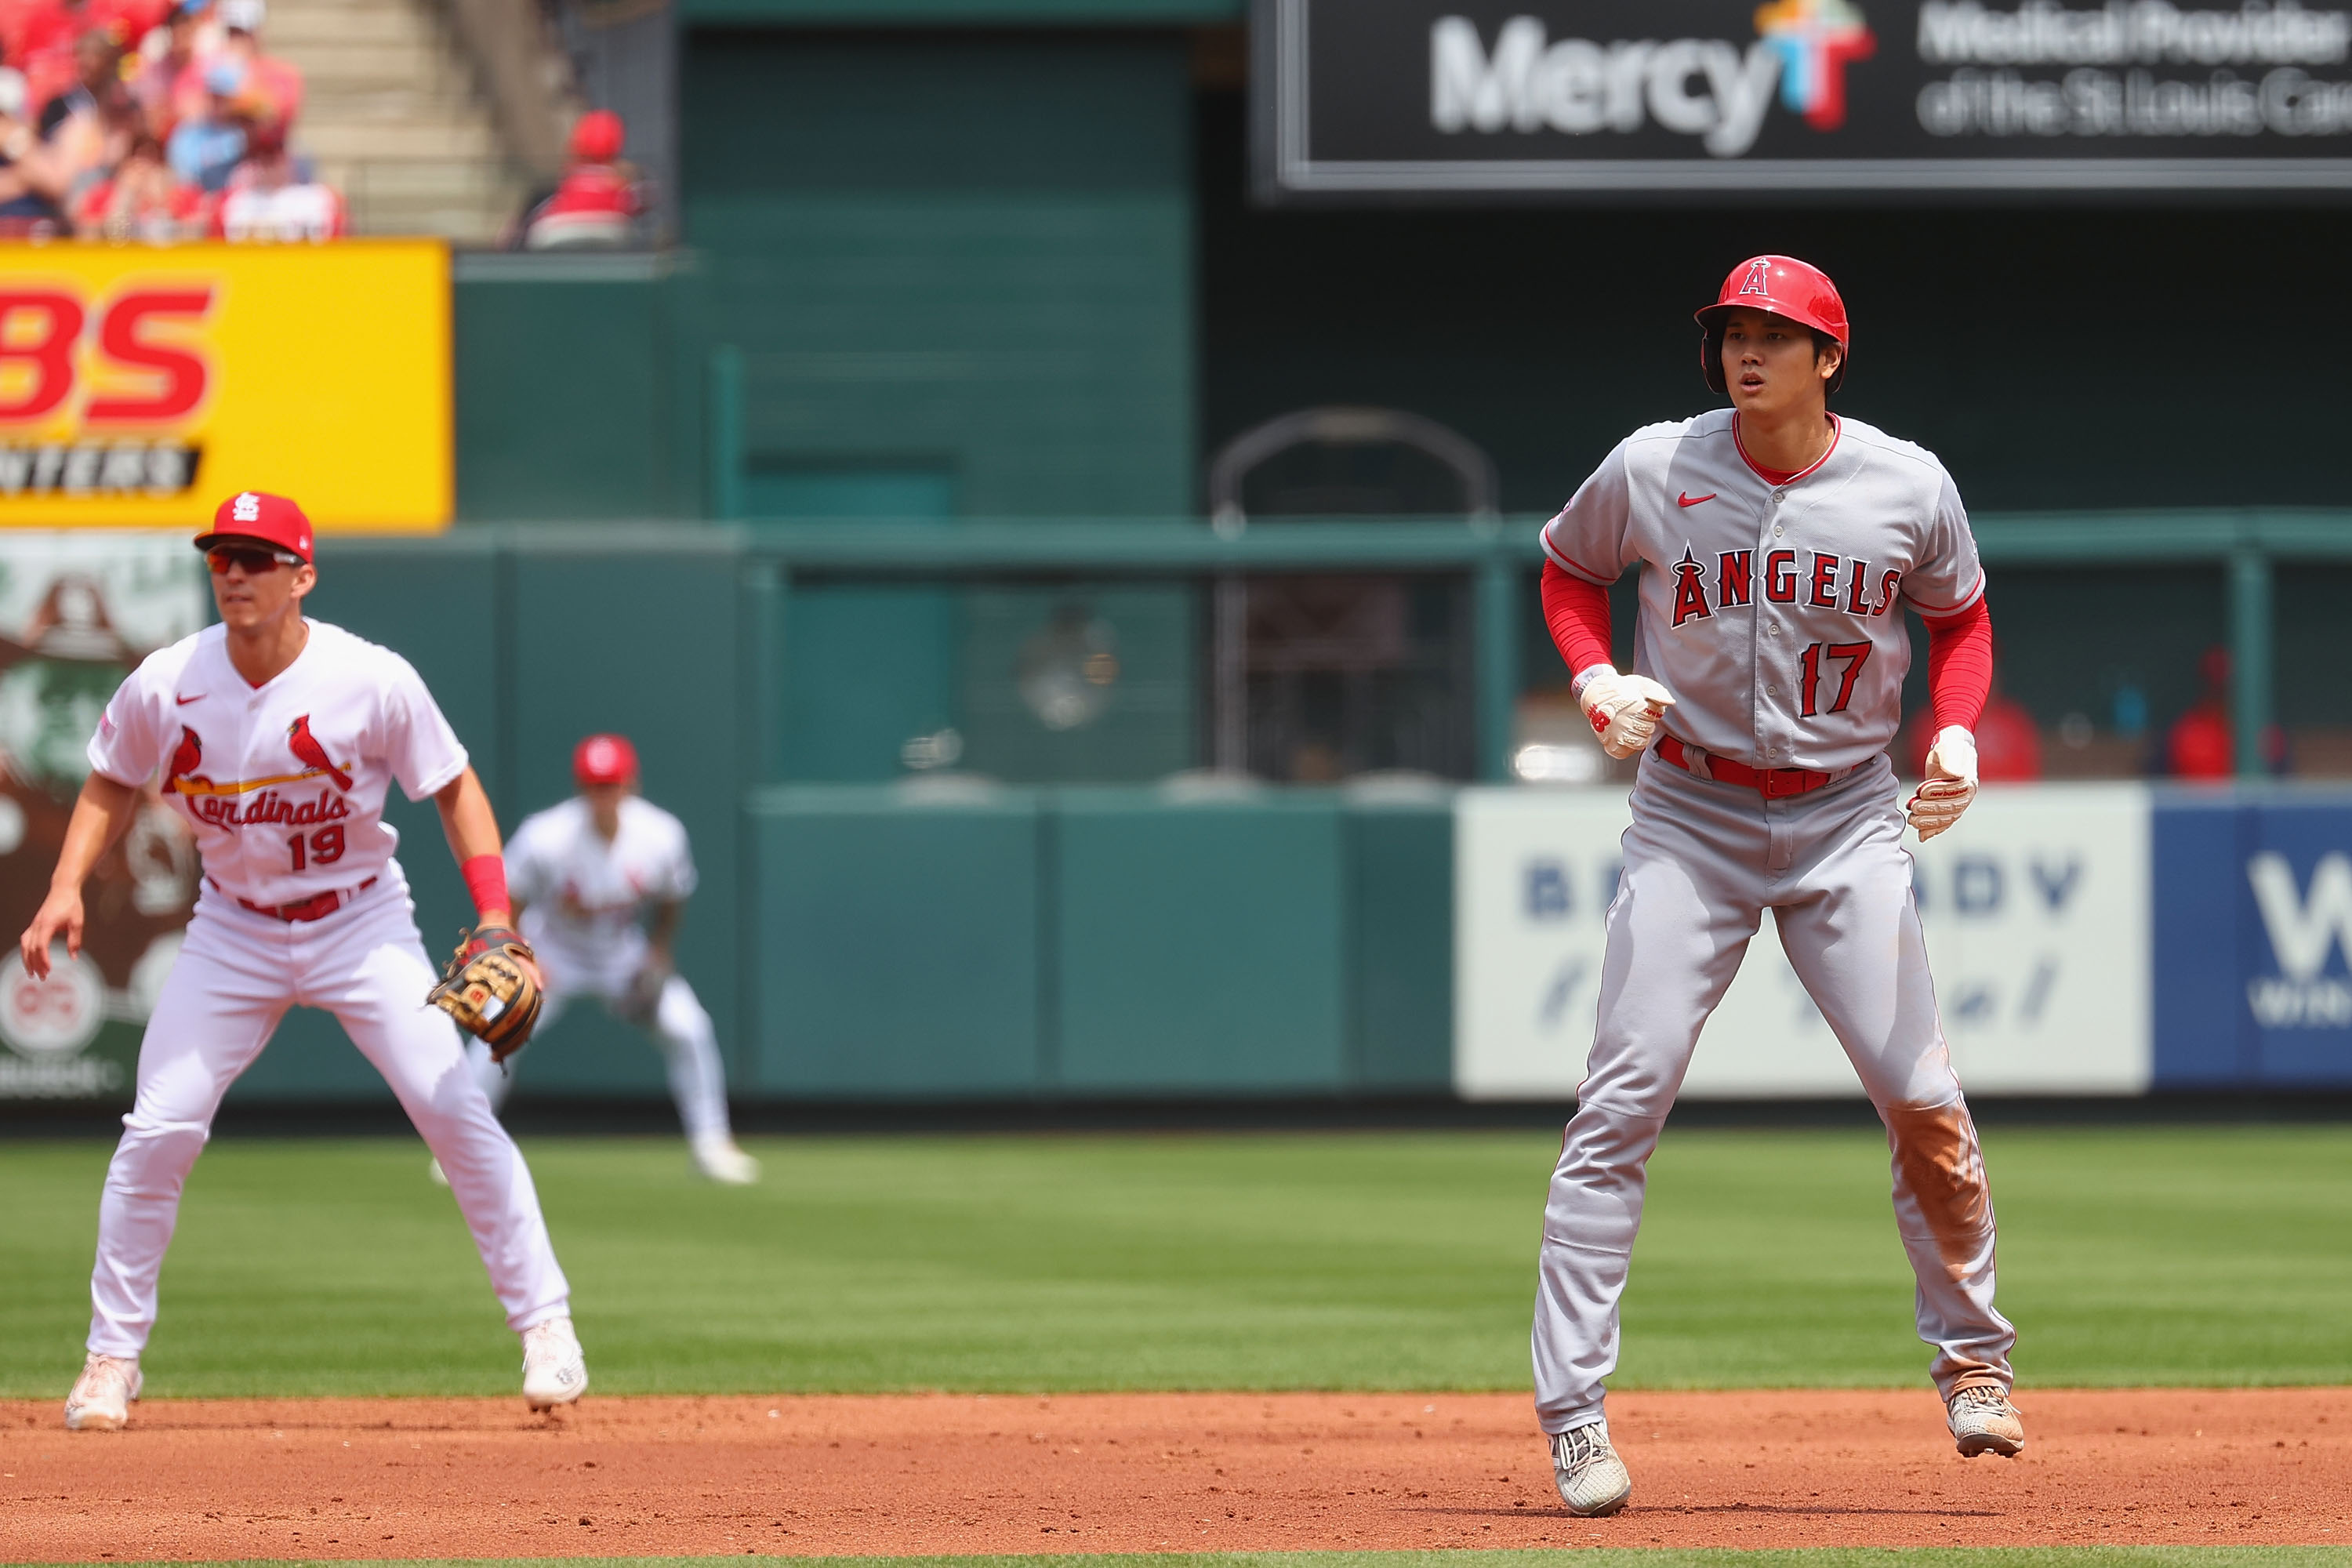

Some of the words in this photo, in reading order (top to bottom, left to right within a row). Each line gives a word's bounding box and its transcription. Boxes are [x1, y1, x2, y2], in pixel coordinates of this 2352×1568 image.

[1916, 0, 2123, 64] Medical
[1430, 14, 1783, 157] Mercy
[1739, 257, 1769, 296] A
[1671, 539, 1902, 630] ANGELS
[1799, 640, 1872, 718] 17
[186, 789, 350, 833] Cardinals
[287, 825, 346, 871] 19
